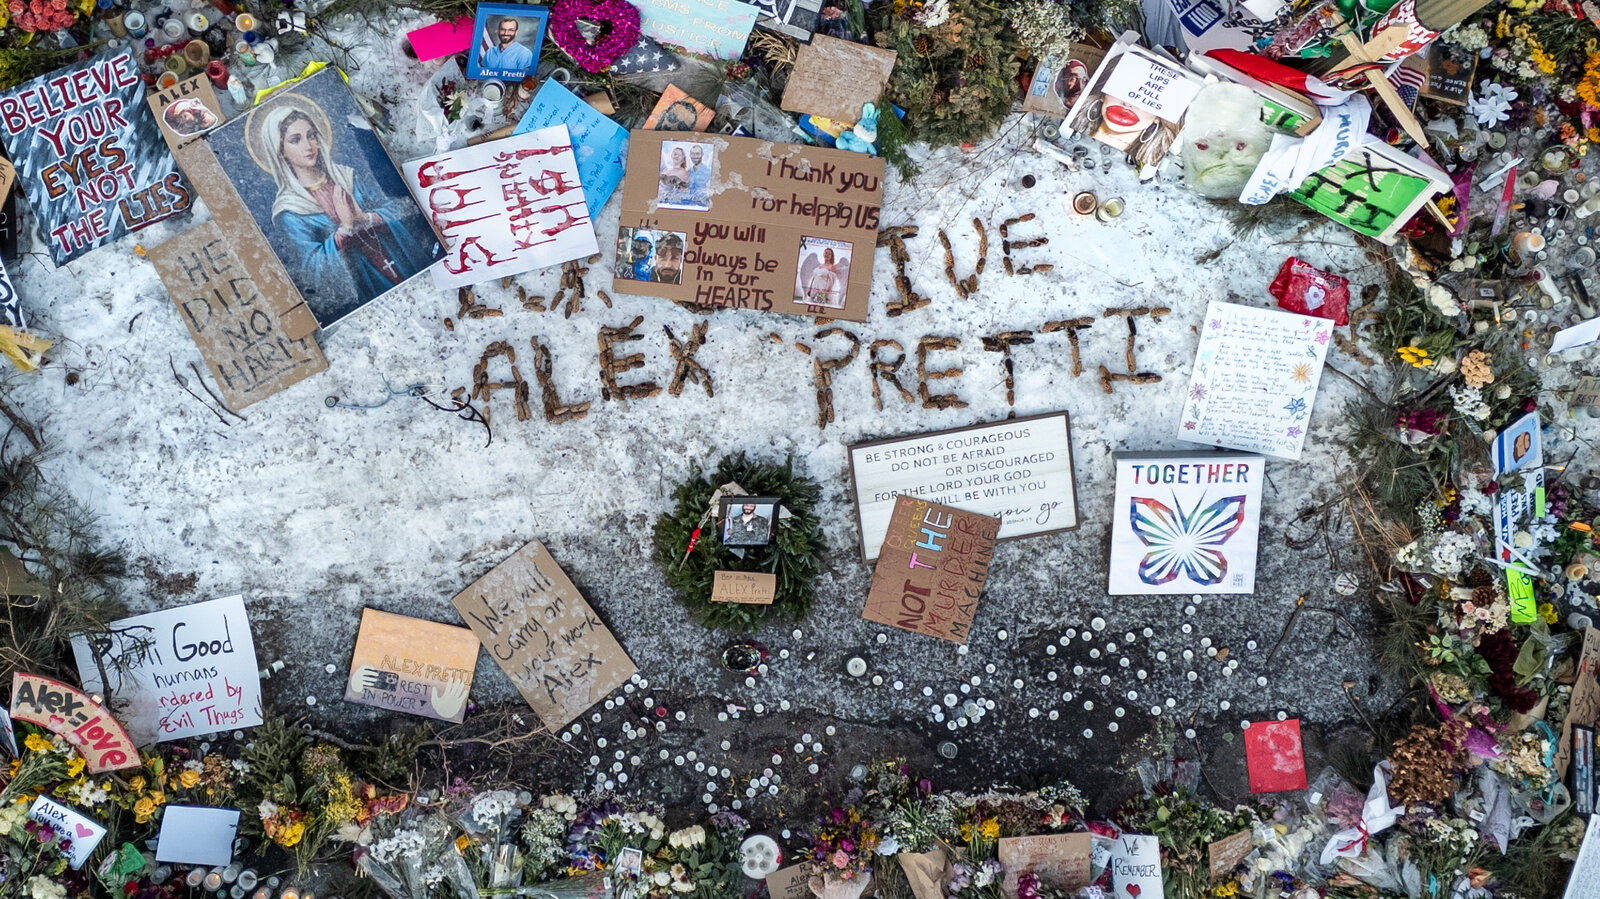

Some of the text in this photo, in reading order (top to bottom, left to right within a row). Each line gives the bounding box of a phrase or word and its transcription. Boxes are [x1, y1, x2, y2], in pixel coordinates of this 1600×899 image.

[692, 17, 747, 41] FROM
[479, 69, 526, 79] Alex Pretti
[1149, 73, 1170, 85] LIPS
[1150, 62, 1179, 80] THESE
[0, 53, 138, 135] BELIEVE
[159, 78, 201, 107] ALEX
[1128, 91, 1163, 111] OF LIES
[1138, 86, 1160, 101] FULL
[1144, 81, 1165, 93] ARE
[38, 99, 129, 158] YOUR
[42, 135, 127, 199] EYES
[766, 154, 878, 194] Thank you
[76, 163, 136, 212] NOT
[493, 151, 556, 252] KILLING
[51, 209, 111, 255] THE
[118, 171, 191, 230] LIES
[418, 157, 518, 274] STOP
[790, 193, 853, 229] helppig
[855, 204, 881, 231] US
[693, 222, 767, 245] you will
[177, 239, 232, 287] HE
[684, 246, 779, 275] always be
[696, 266, 760, 287] in our
[695, 284, 775, 311] HEARTS
[221, 308, 273, 353] NO
[471, 314, 714, 425] ALEX
[813, 306, 1172, 430] PRETTI
[1576, 393, 1599, 404] REST
[865, 429, 1031, 463] BE STRONG & COURAGEOUS
[891, 446, 1006, 472] DO NOT BE AFRAID
[945, 451, 1055, 477] OR DISCOURAGED
[1131, 463, 1250, 485] TOGETHER
[874, 469, 1032, 502] FOR THE LORD YOUR GOD
[931, 481, 1047, 505] WILL BE WITH YOU
[904, 500, 927, 551] QUEENS
[1036, 500, 1064, 525] go
[896, 507, 953, 629] NOT THE
[923, 517, 977, 636] MURDER
[719, 583, 748, 595] ALEX
[950, 531, 997, 638] MACHINE
[469, 595, 515, 635] We
[545, 596, 567, 621] on
[172, 614, 234, 663] Good
[515, 611, 602, 689] your work
[152, 666, 219, 689] humans
[380, 655, 474, 685] ALEX PRETTI
[543, 652, 602, 704] Alex
[159, 677, 243, 709] rdered by
[362, 687, 417, 709] IN POWER
[401, 679, 431, 696] REST
[15, 681, 84, 717] Alex
[72, 715, 128, 768] Love
[160, 704, 245, 733] Evil Thugs
[34, 812, 51, 825] You
[790, 872, 810, 886] Alex
